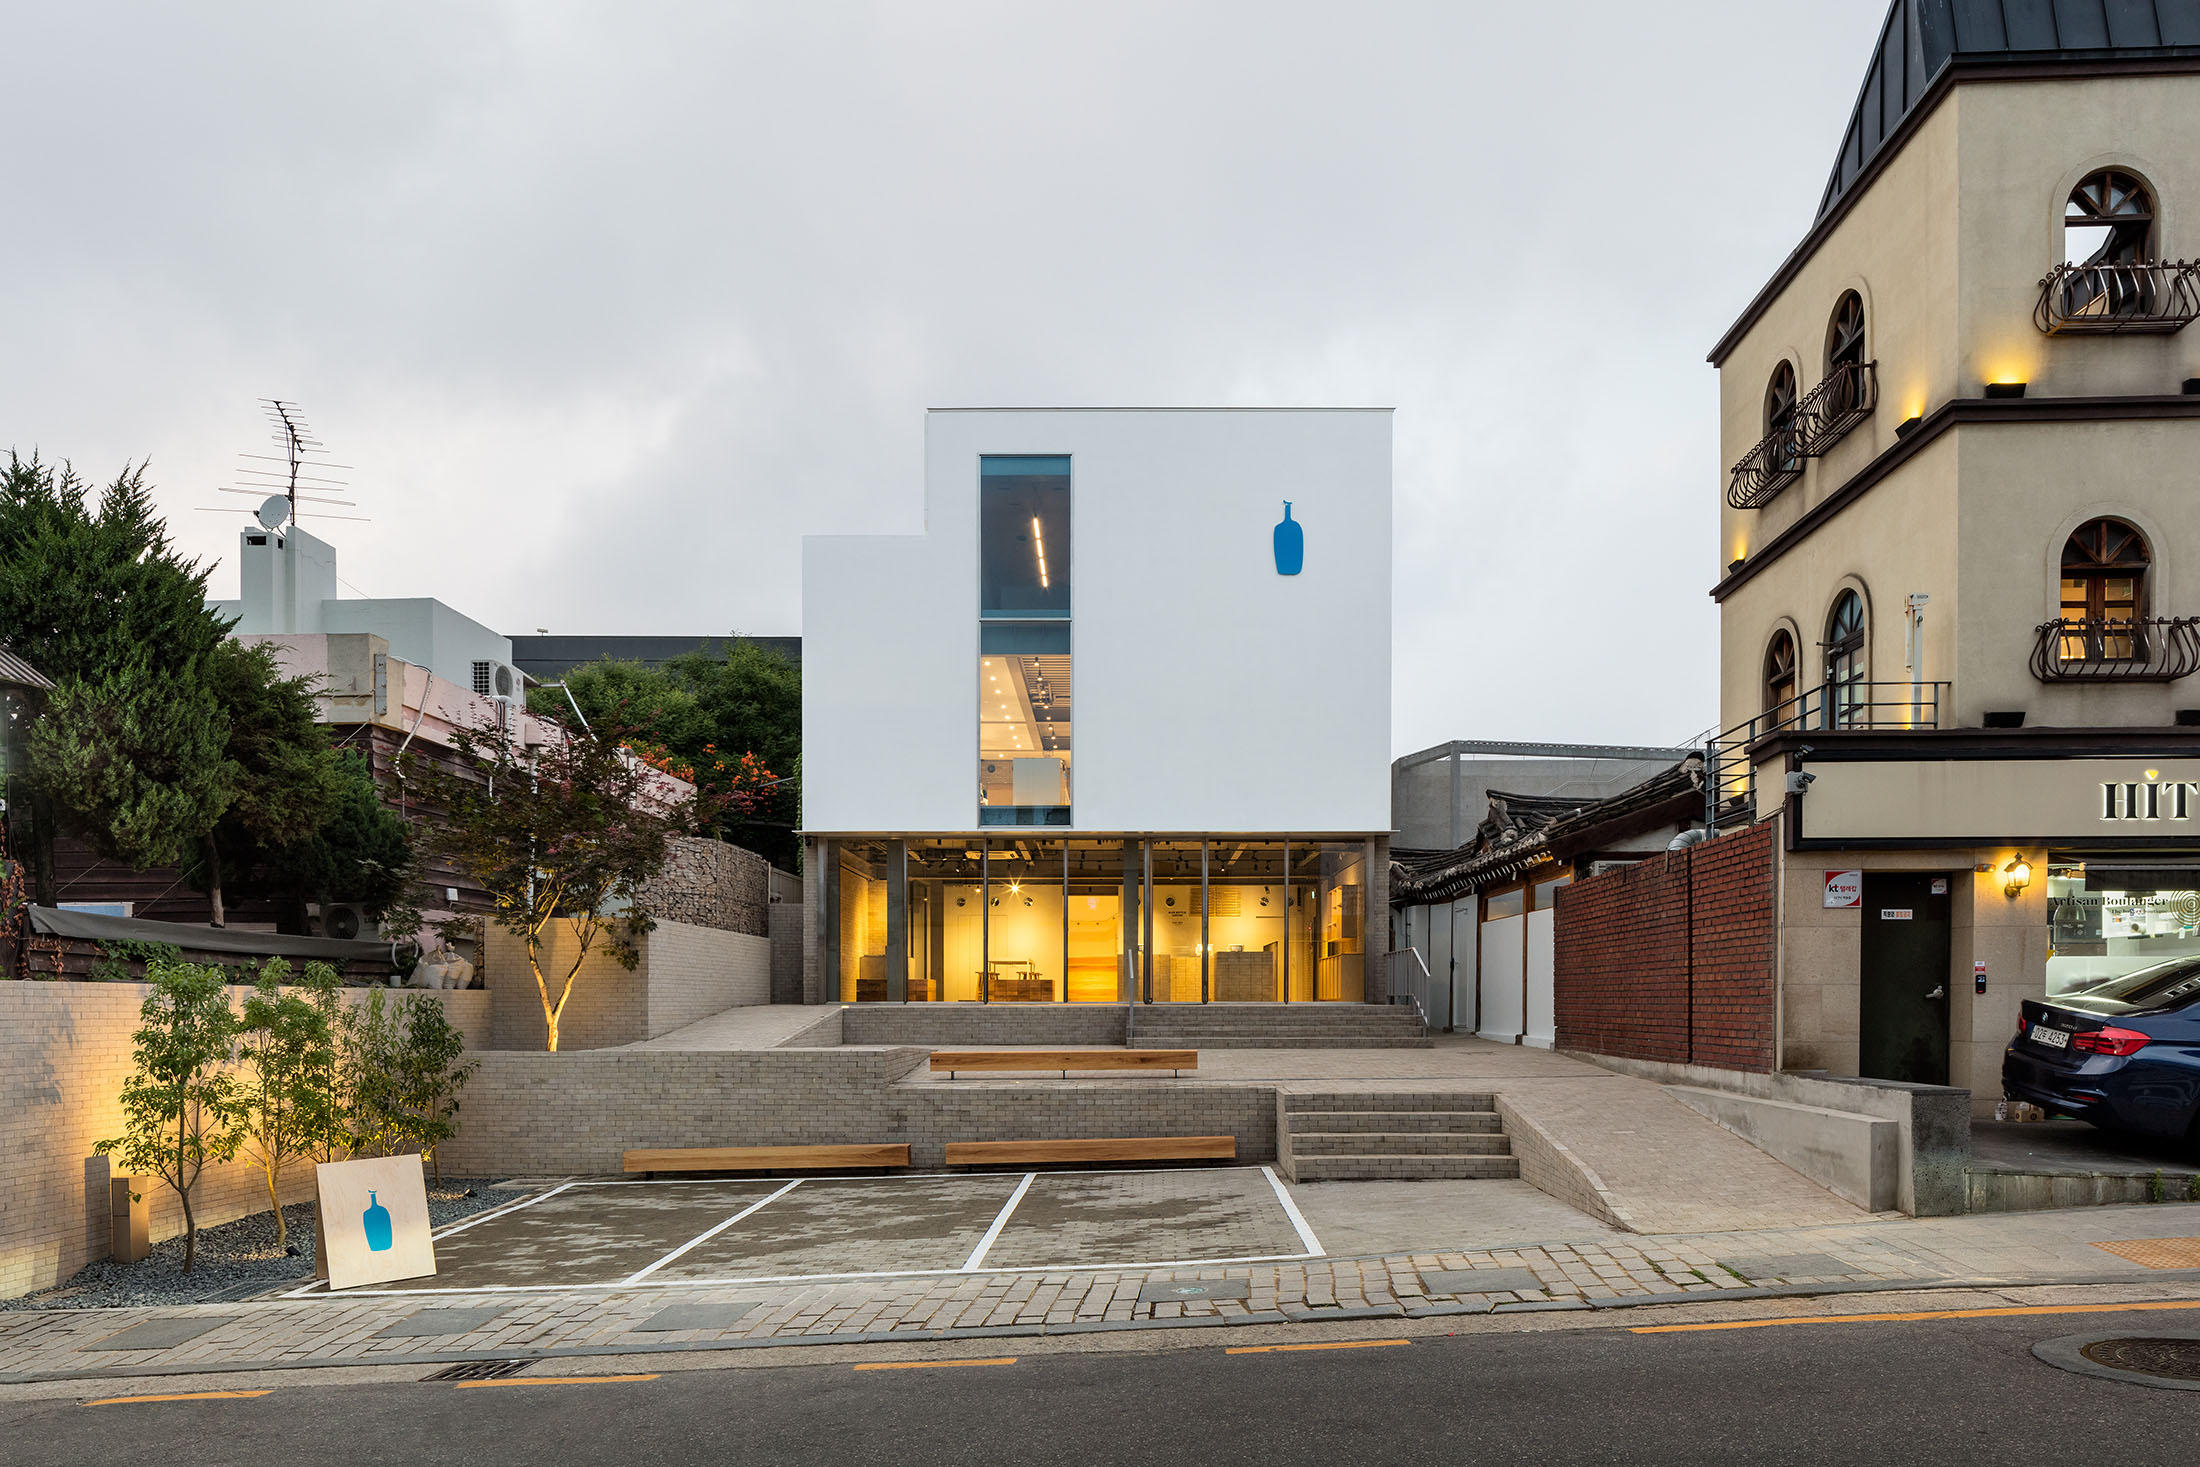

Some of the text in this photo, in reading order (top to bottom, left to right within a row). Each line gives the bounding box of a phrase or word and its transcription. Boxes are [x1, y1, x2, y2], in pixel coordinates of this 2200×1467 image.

[1829, 884, 1839, 893] kt
[2050, 896, 2169, 907] Artisan Boulanger
[2048, 1031, 2066, 1045] 4253
